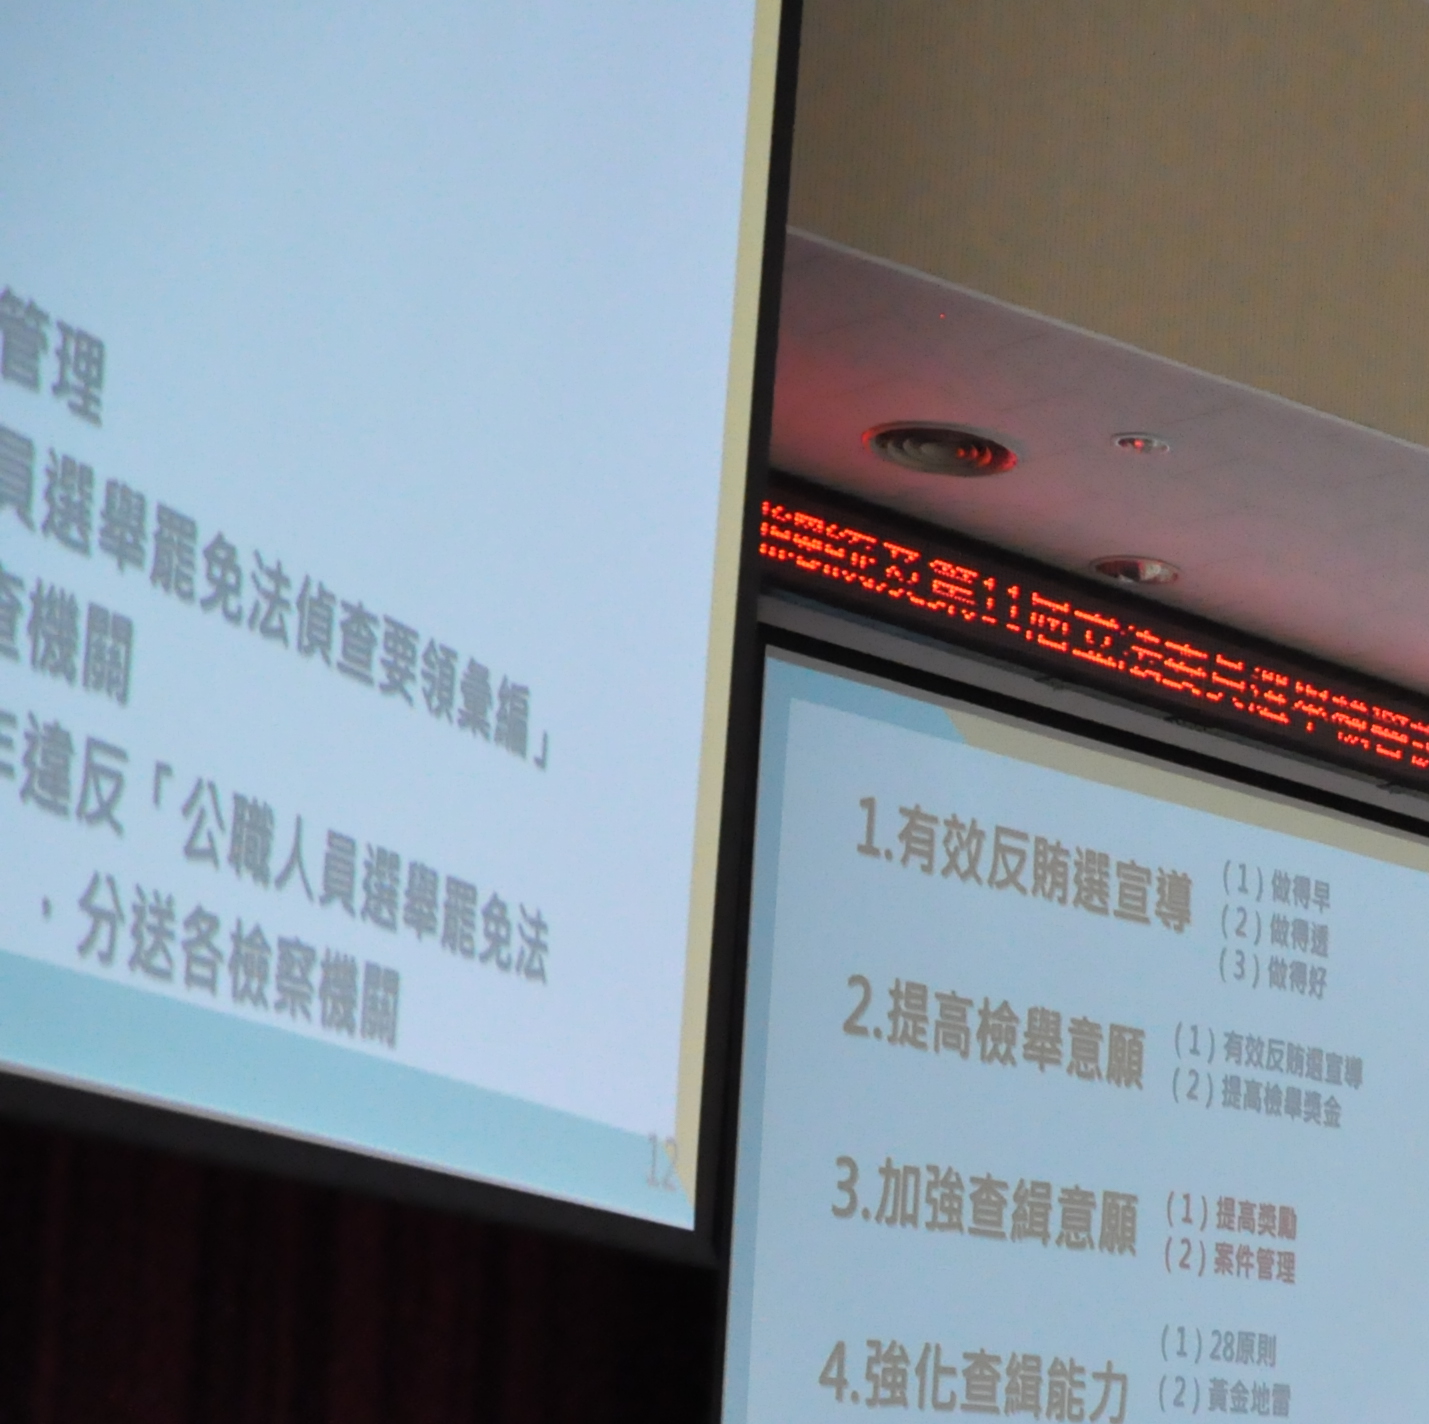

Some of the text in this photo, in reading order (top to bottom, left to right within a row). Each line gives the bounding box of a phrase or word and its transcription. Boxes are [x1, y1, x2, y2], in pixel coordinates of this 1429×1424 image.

[0, 284, 106, 428] 管理
[0, 709, 550, 986] 違反「公職人員選舉罷免法
